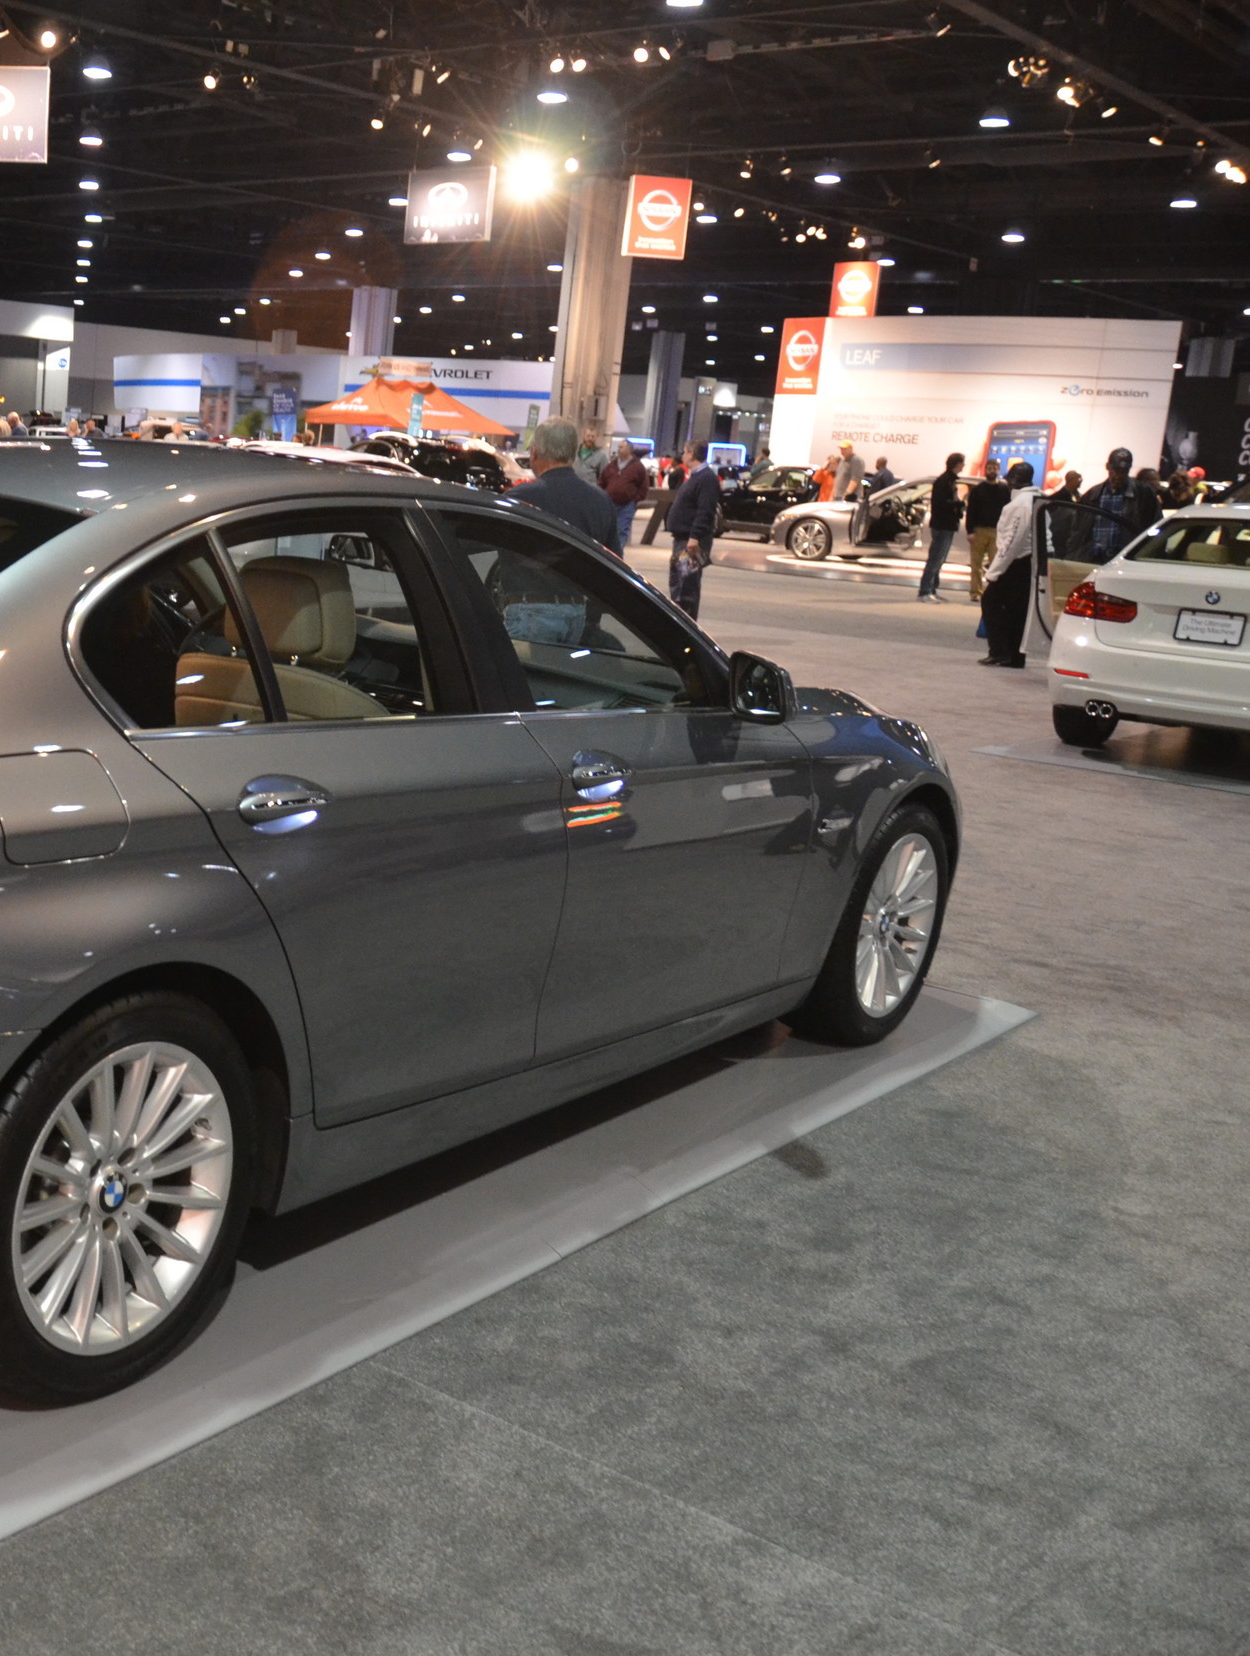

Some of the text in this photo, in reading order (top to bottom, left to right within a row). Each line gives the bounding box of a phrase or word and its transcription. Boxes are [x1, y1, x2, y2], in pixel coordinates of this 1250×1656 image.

[845, 349, 882, 366] LEAF
[831, 430, 919, 445] REMOTE CHARGE
